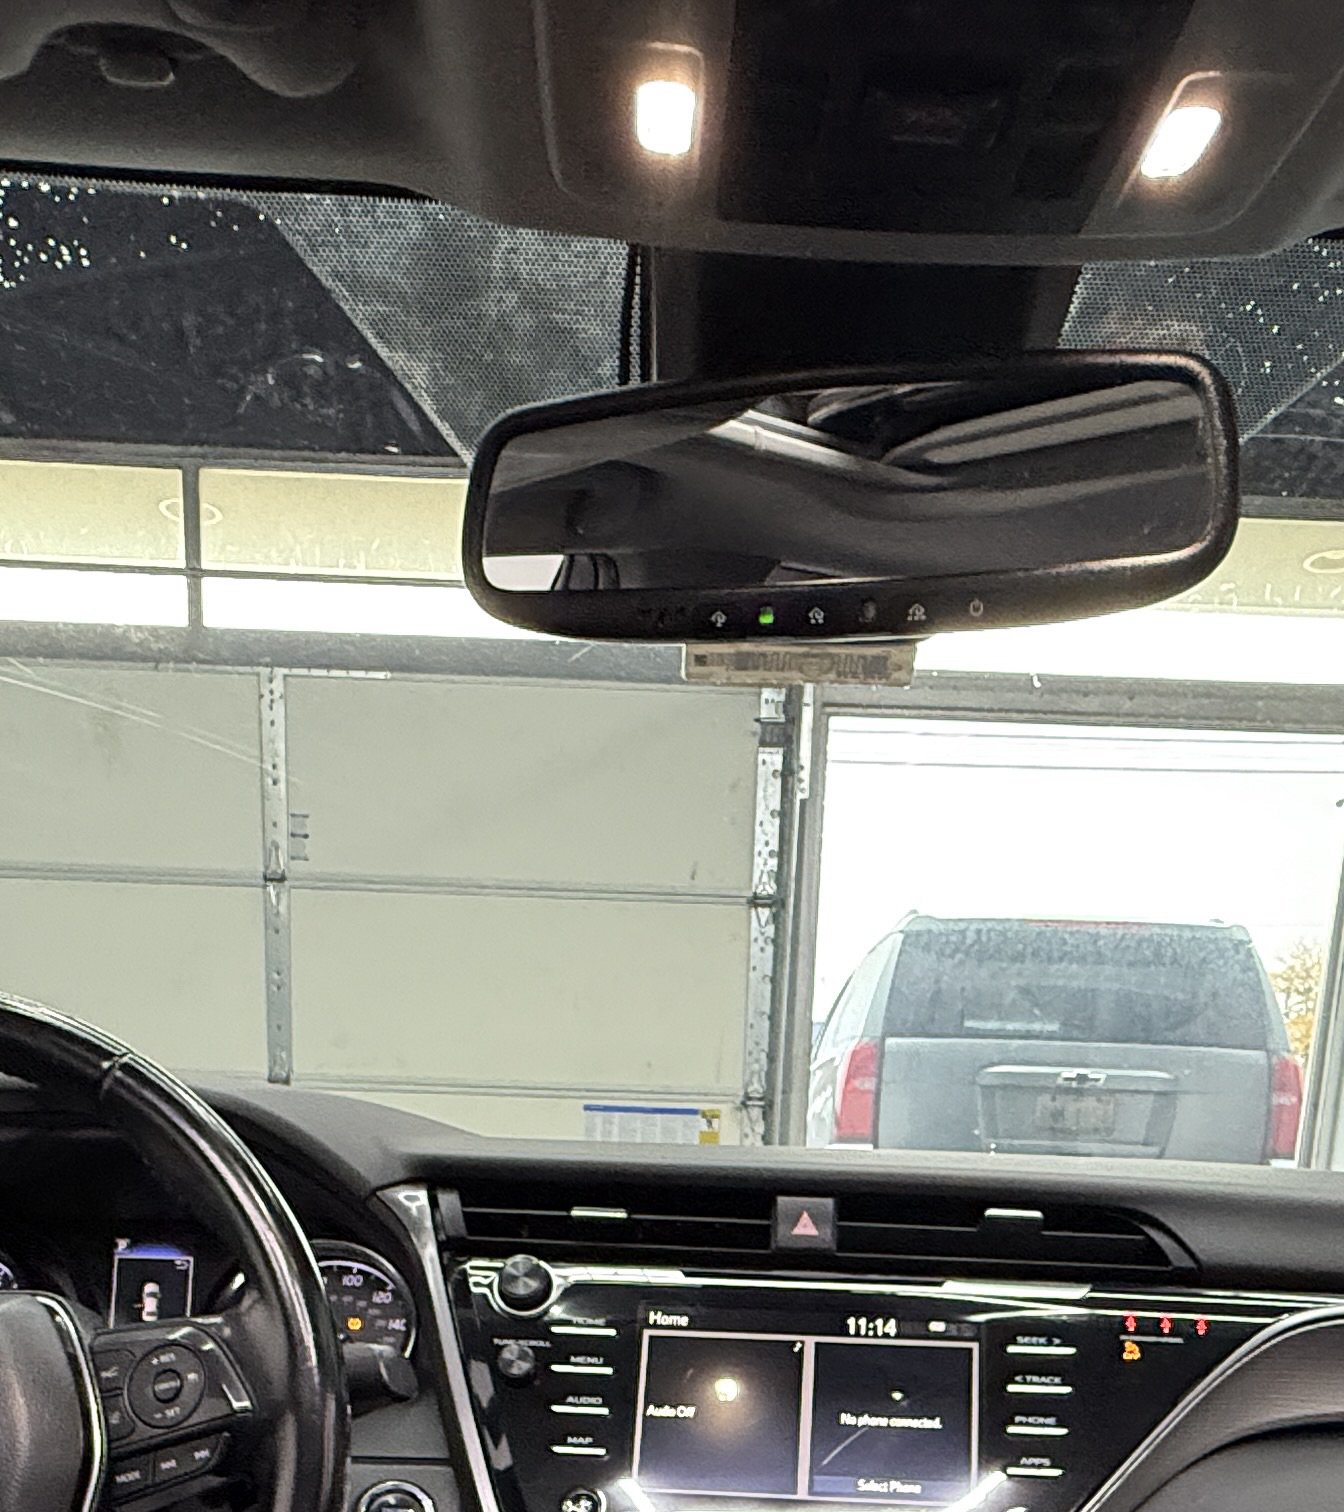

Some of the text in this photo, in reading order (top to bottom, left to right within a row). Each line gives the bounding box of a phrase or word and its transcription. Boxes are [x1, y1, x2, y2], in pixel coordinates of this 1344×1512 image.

[342, 1274, 364, 1287] 100
[648, 1310, 690, 1327] Home
[846, 1316, 898, 1338] 11:14
[1015, 1335, 1049, 1345] SEEK
[569, 1354, 605, 1365] MENU
[1024, 1375, 1062, 1384] TRACK
[565, 1395, 603, 1405] AUDIO
[645, 1404, 696, 1418] Audio Off
[858, 1414, 888, 1428] phone
[1014, 1415, 1057, 1425] PHONE
[566, 1436, 594, 1445] MAP
[1019, 1457, 1052, 1466] APPS
[857, 1478, 922, 1494] Select Phone
